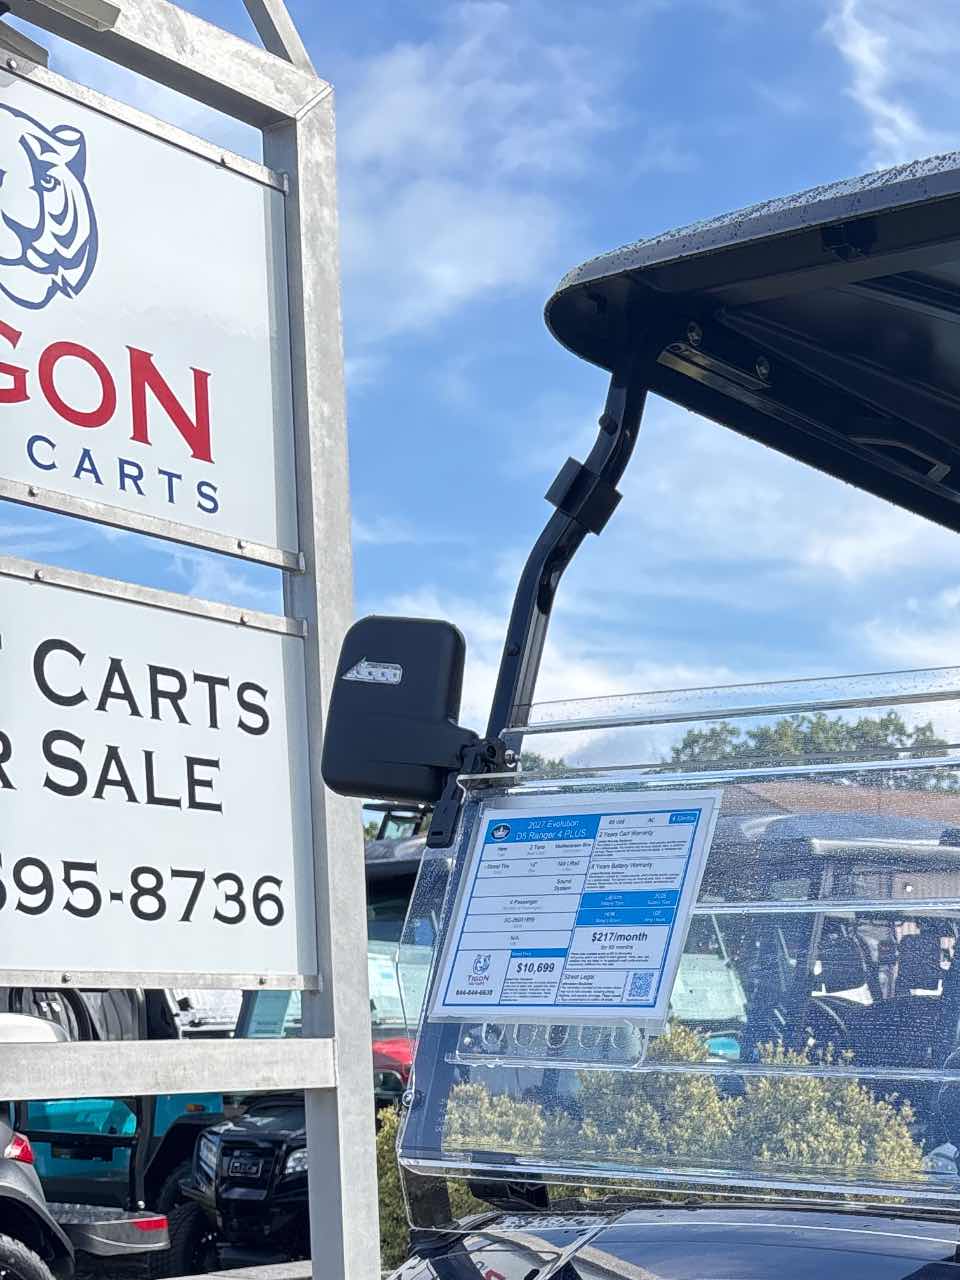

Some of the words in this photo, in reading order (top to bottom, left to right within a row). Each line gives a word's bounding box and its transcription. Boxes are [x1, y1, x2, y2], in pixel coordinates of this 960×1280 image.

[26, 434, 220, 514] CARTS
[33, 638, 270, 736] CARTS
[42, 729, 224, 814] SALE
[0, 853, 284, 927] 95-8736
[516, 962, 555, 974] $10,699
[592, 931, 648, 943] $217/month
